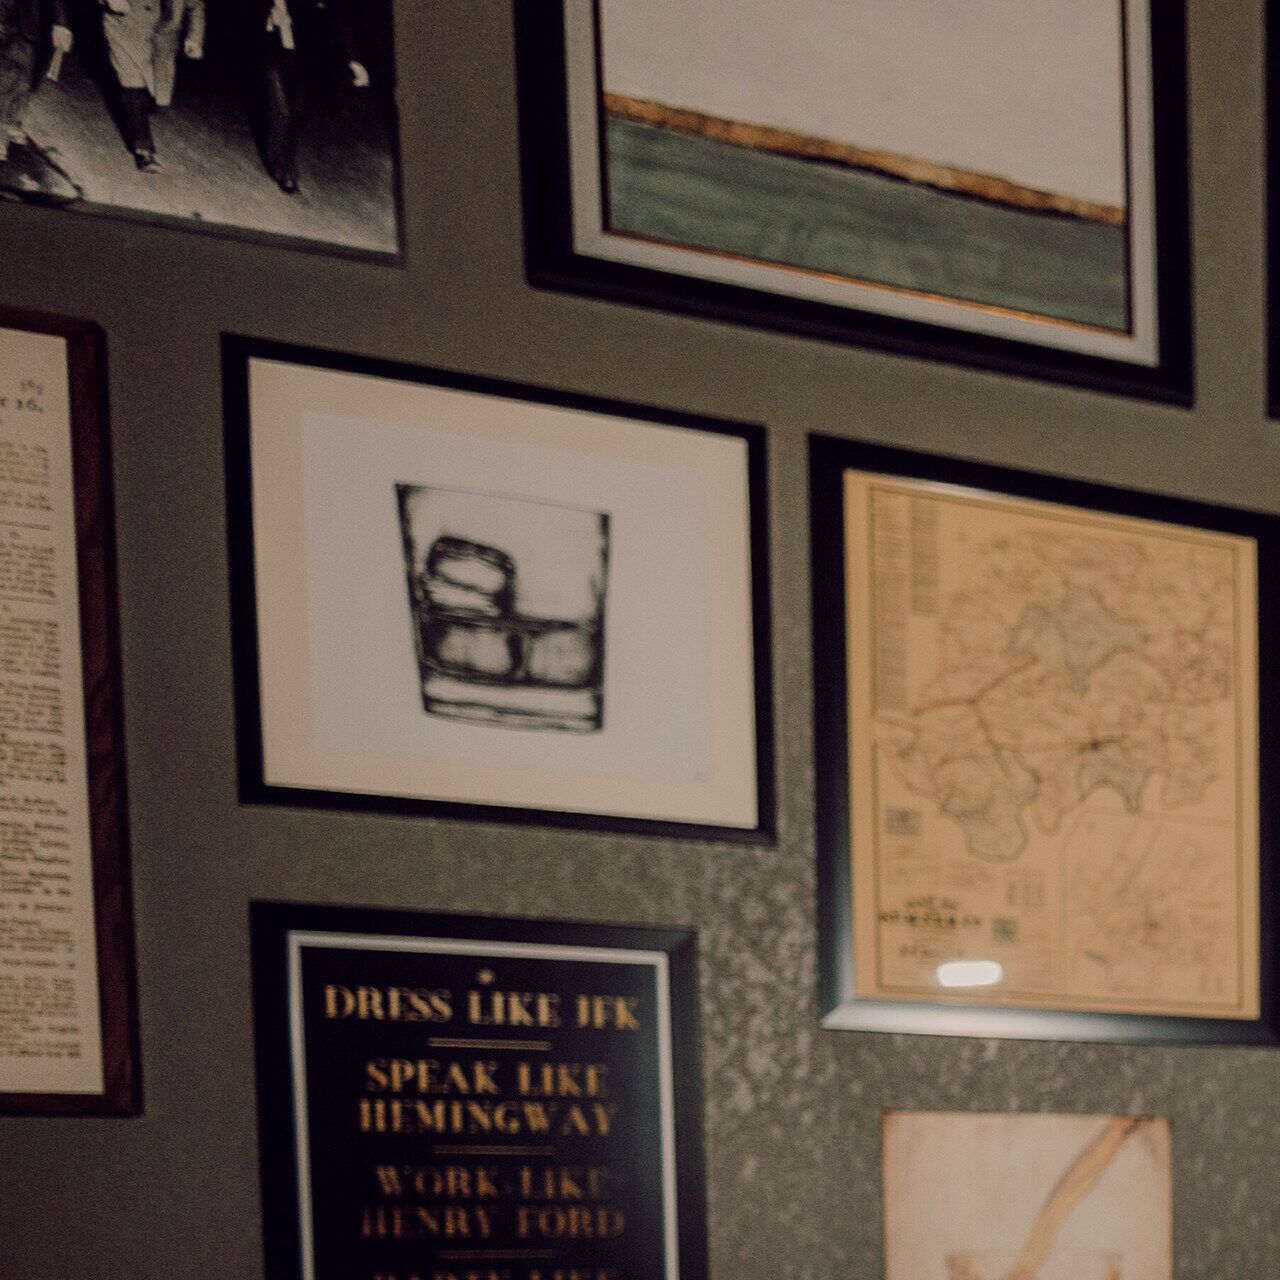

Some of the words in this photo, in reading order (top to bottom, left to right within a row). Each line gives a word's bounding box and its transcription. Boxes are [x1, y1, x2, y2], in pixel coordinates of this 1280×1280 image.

[324, 984, 453, 1022] DRESS
[467, 989, 561, 1028] LIKE
[365, 1057, 500, 1095] SPEAK
[517, 1060, 609, 1098] LIKE
[359, 1098, 619, 1137] HEMINGWAY
[375, 1163, 499, 1199] WORK
[518, 1164, 609, 1200] LIKE
[360, 1204, 498, 1239] HENRY
[516, 1204, 626, 1239] FORD
